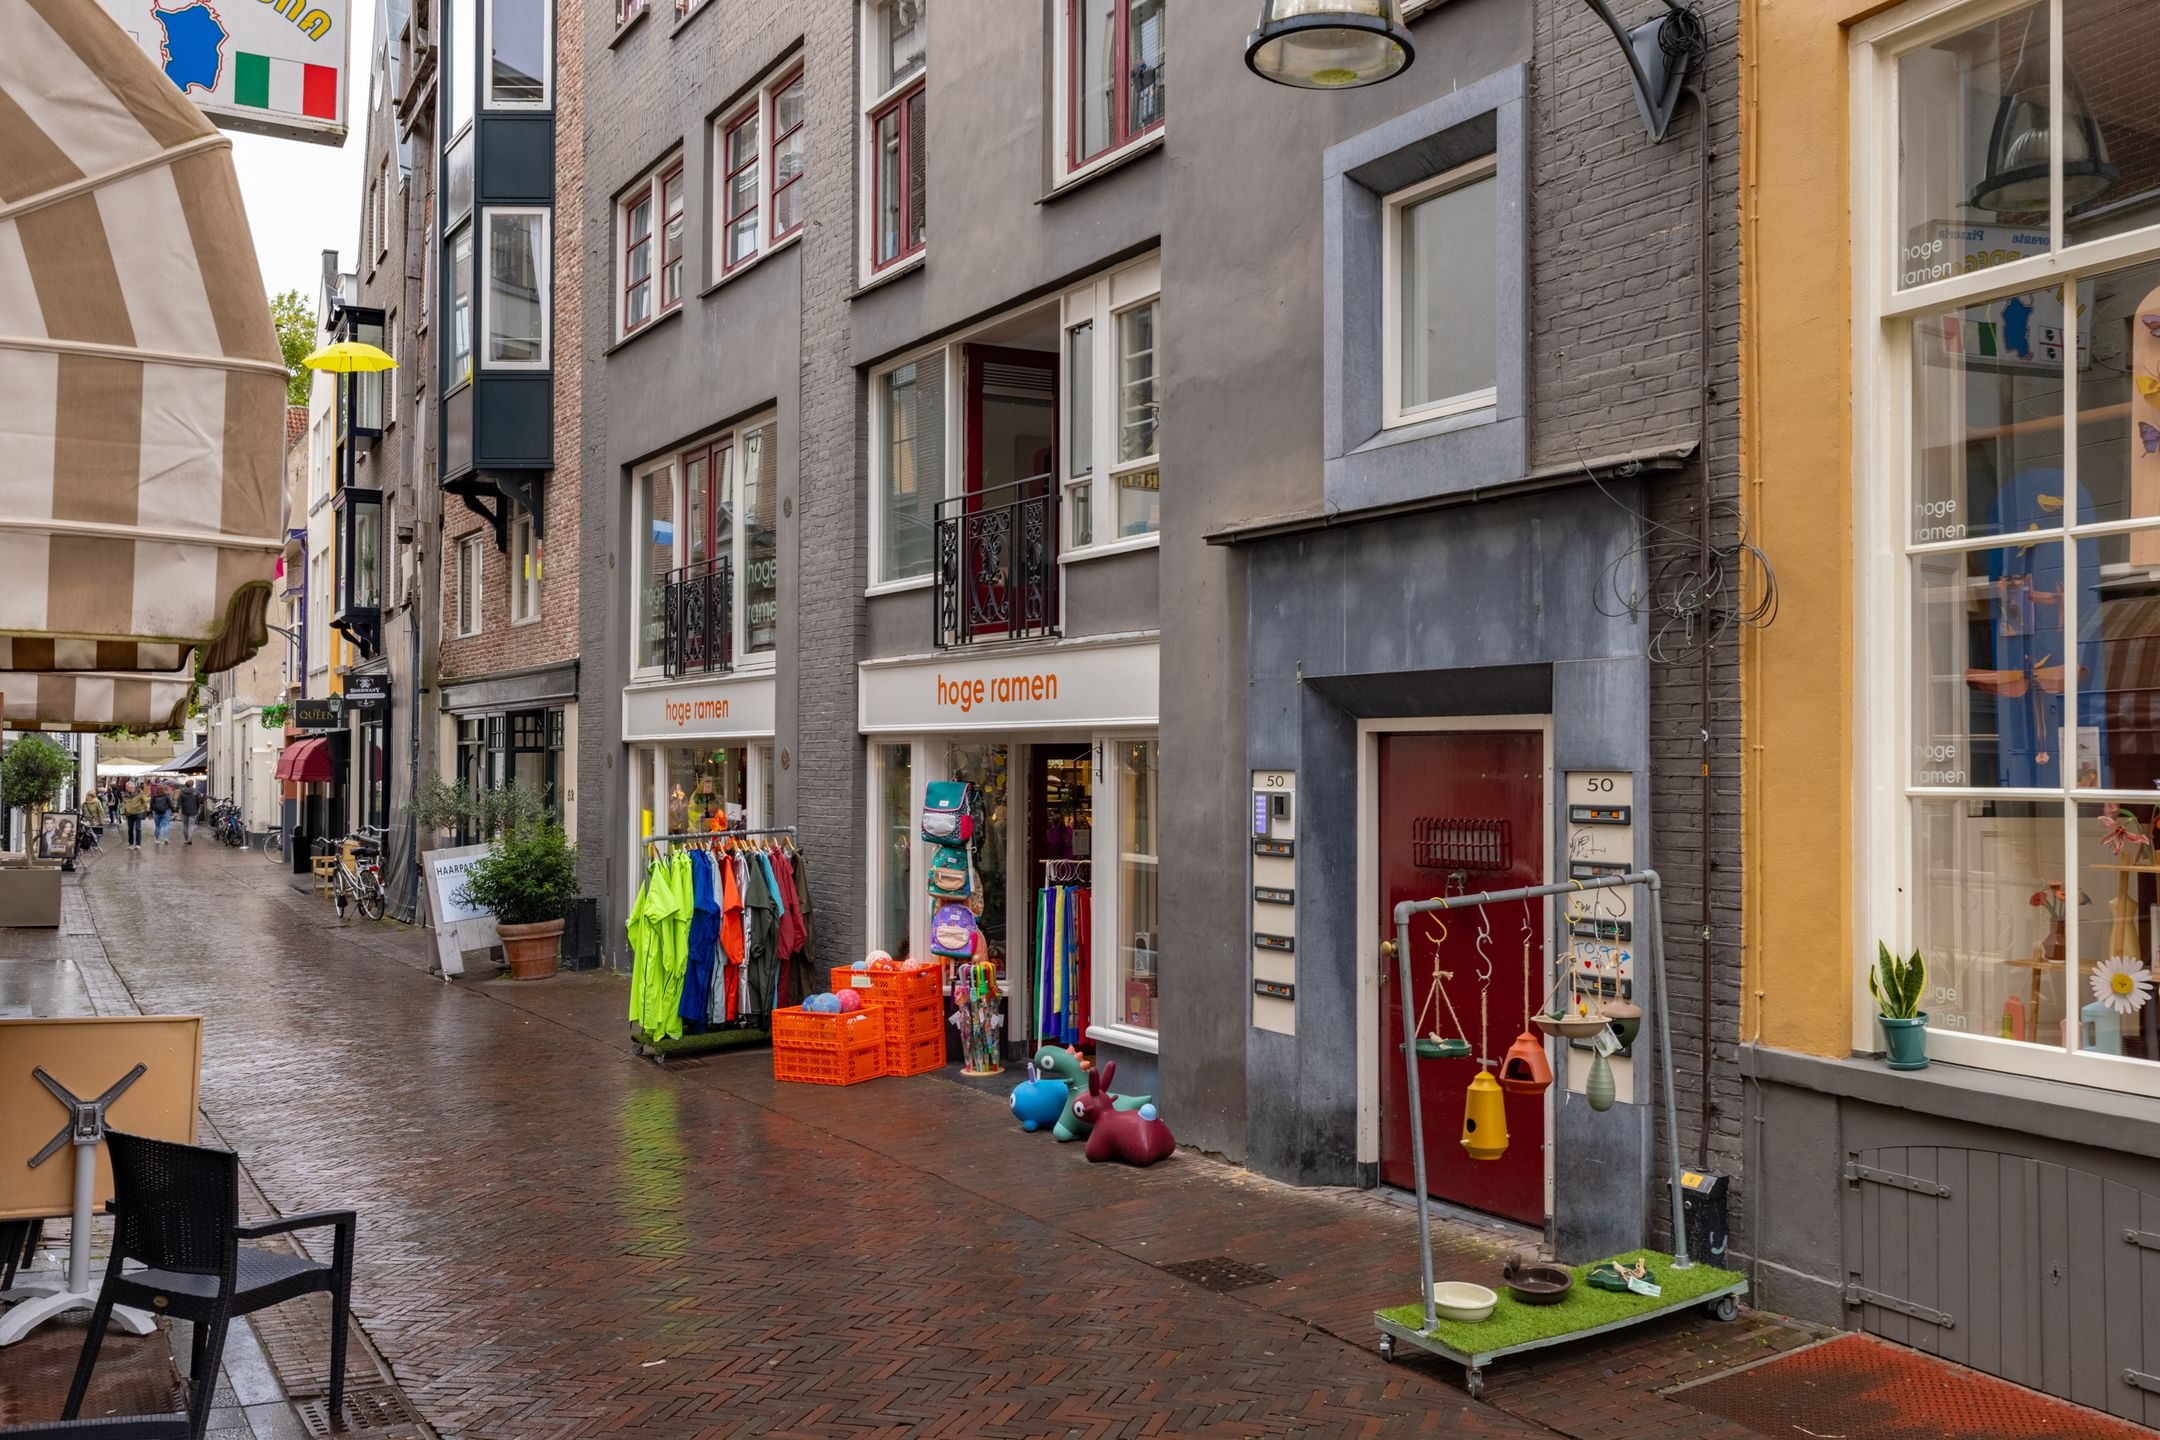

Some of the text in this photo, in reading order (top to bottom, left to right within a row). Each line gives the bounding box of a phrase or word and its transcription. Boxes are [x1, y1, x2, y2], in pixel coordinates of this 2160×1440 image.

[256, 0, 332, 42] NA
[1915, 500, 1956, 518] hoge
[1914, 524, 1966, 541] ramen
[937, 674, 1057, 712] hoge ramen
[300, 711, 334, 720] QUEEN
[665, 698, 729, 726] hoge ramen
[1266, 775, 1284, 787] 50
[1586, 777, 1614, 792] 50
